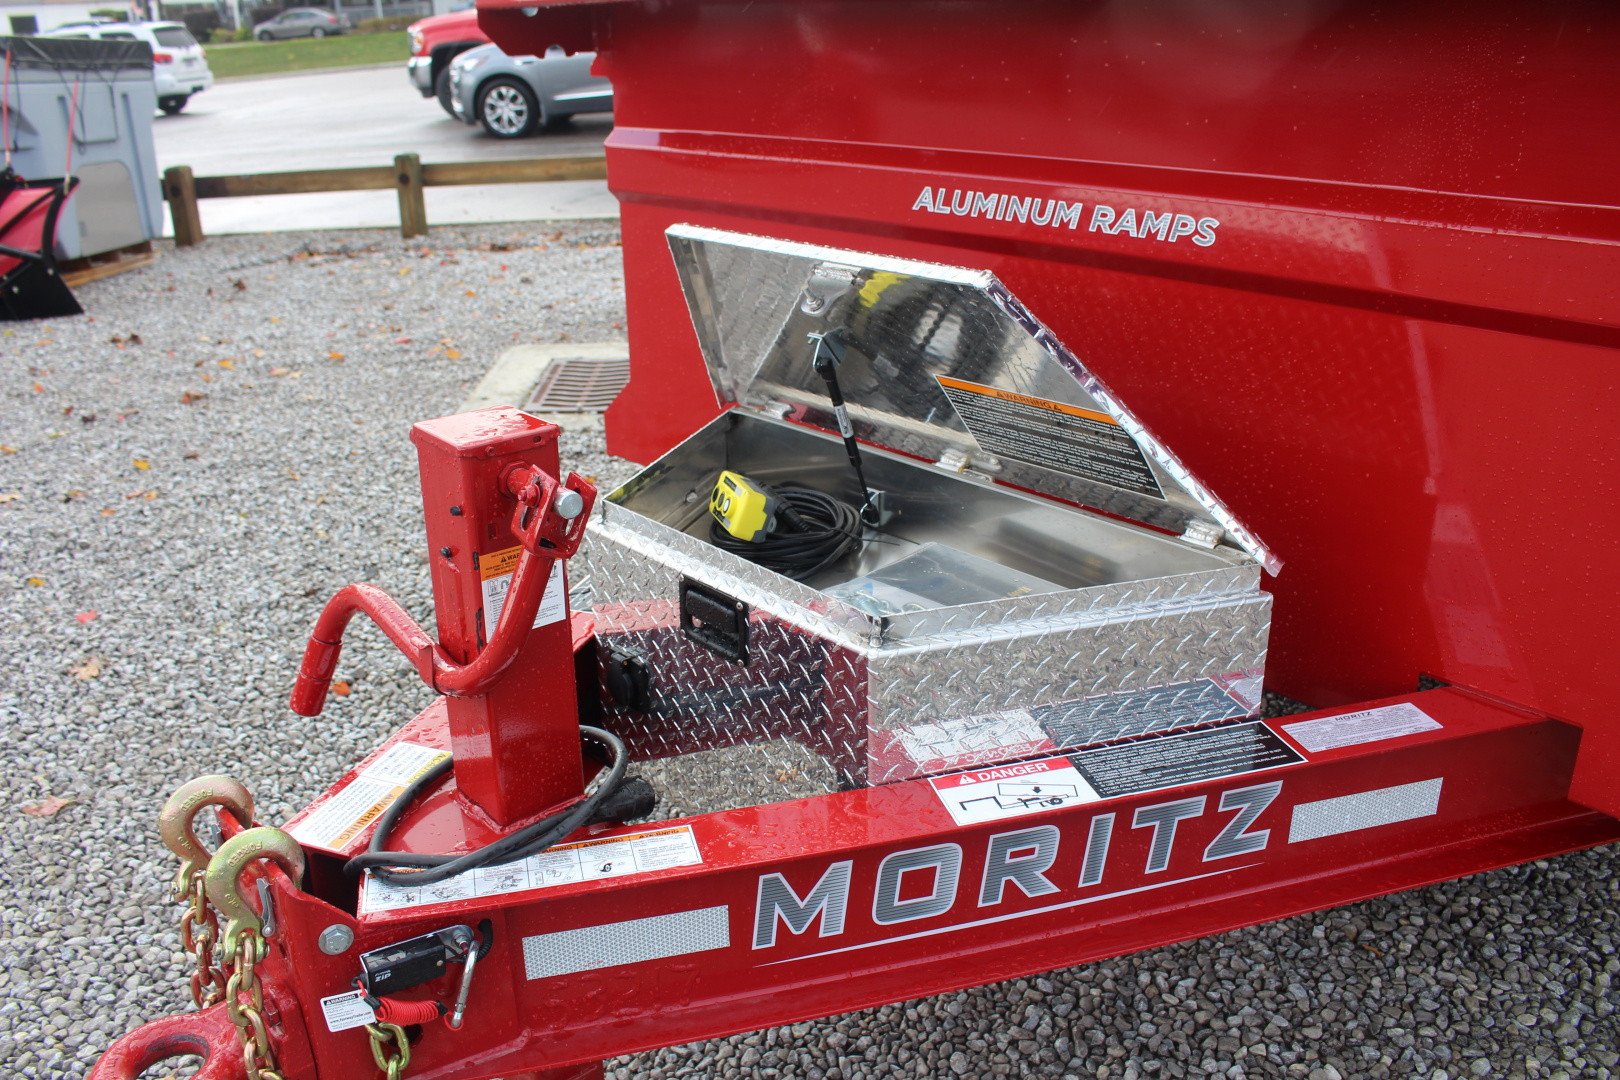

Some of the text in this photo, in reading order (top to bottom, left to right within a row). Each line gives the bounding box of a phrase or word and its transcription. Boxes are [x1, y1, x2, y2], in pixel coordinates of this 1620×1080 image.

[912, 186, 1220, 247] ALUMINUM RAMPS
[1003, 392, 1052, 409] WARNING
[1335, 711, 1372, 722] MORITZ
[977, 762, 1050, 781] DANGER
[181, 788, 213, 812] FORGED
[339, 798, 390, 840] WARNING
[588, 837, 624, 847] WARNING
[227, 841, 263, 867] FORGED
[751, 780, 1284, 951] MORITZ
[331, 994, 356, 1004] WARNING
